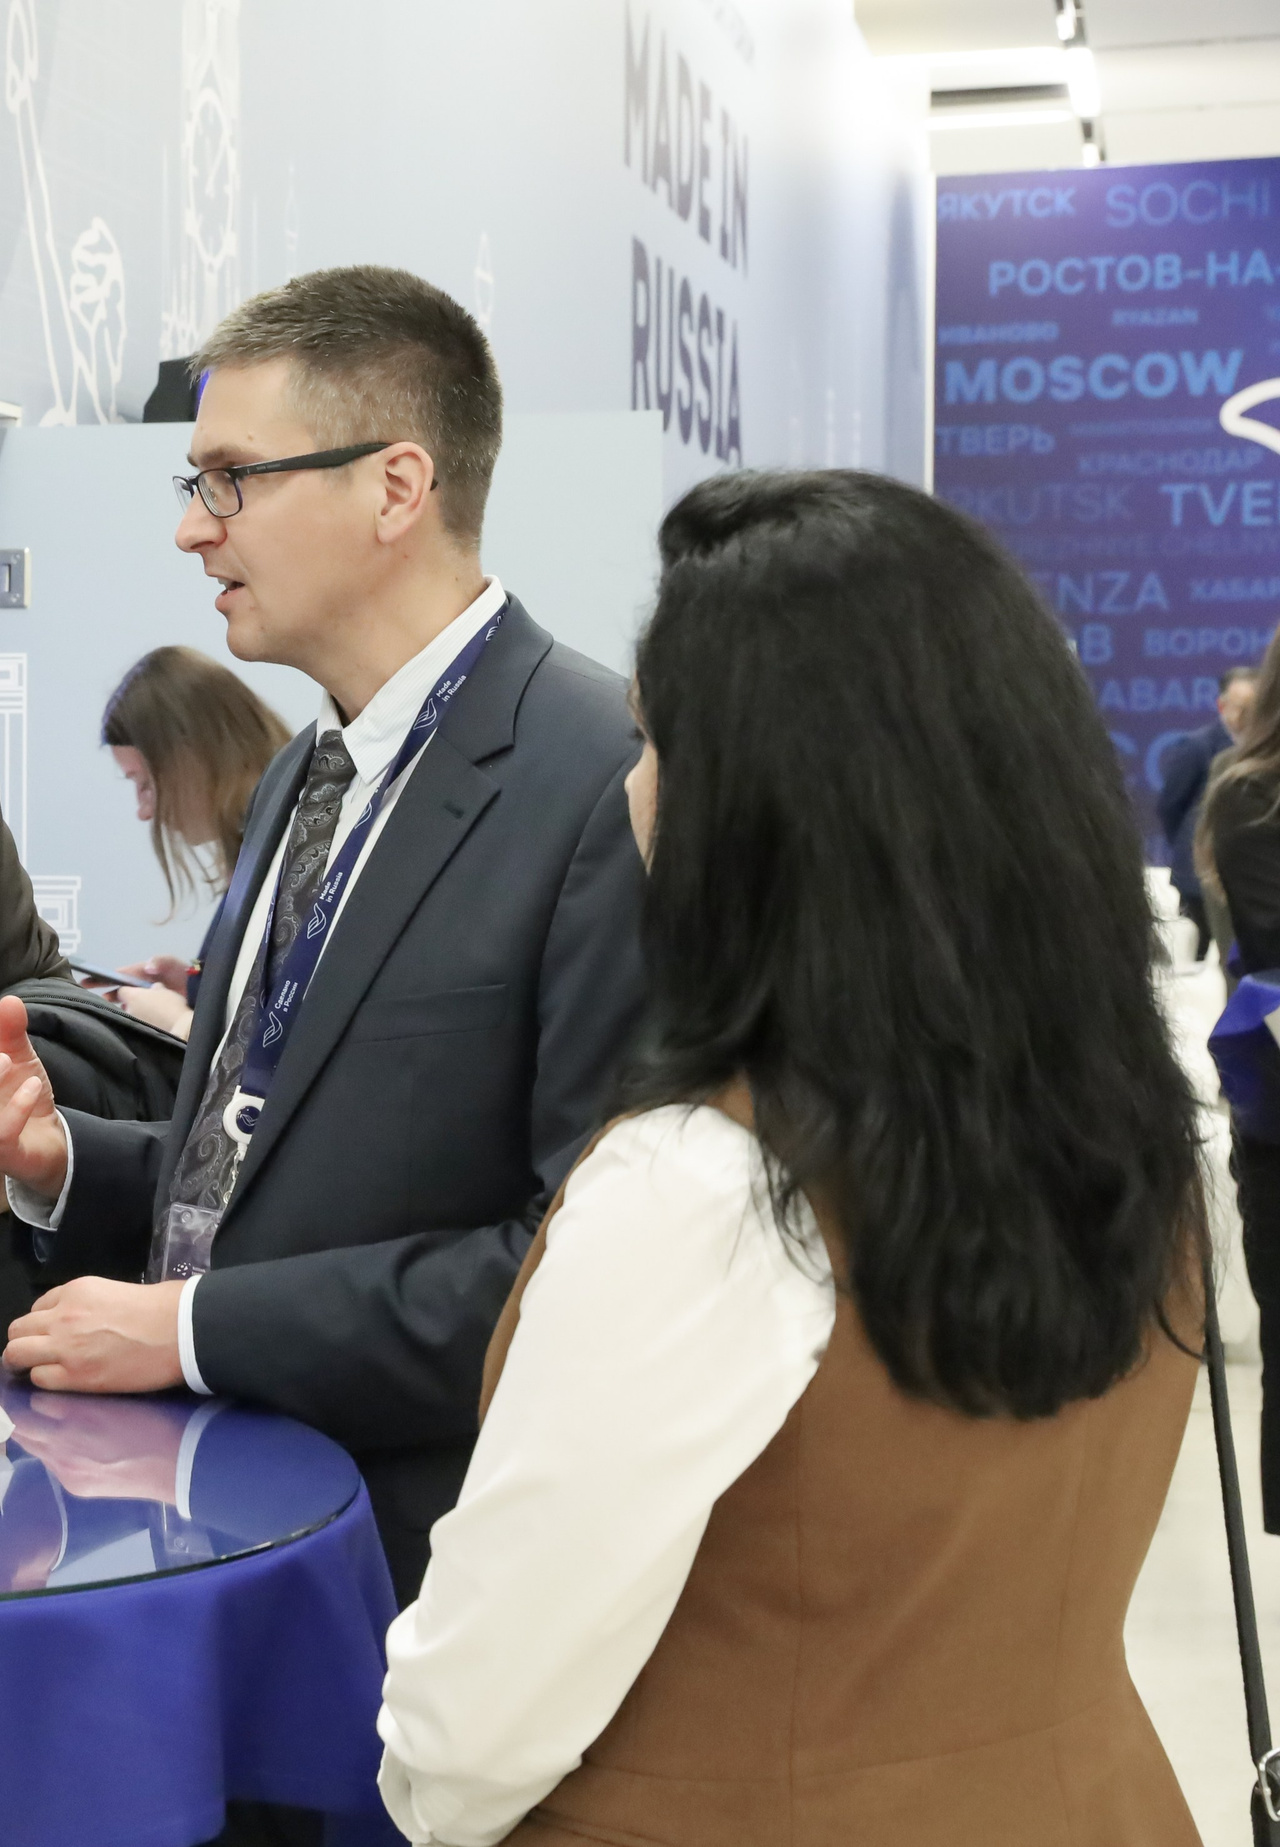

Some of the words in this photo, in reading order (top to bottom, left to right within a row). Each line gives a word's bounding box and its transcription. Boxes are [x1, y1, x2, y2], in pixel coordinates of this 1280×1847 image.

[624, 0, 712, 245] MADE
[719, 104, 750, 280] IN
[1105, 178, 1269, 229] SOCHI
[631, 232, 743, 470] RUSSIA
[943, 348, 1245, 405] MOSCOW
[935, 423, 1057, 456] ТВЕРЬ
[1159, 481, 1280, 527] TVE
[436, 680, 452, 698] Made
[447, 674, 467, 696] Russia
[319, 881, 331, 900] Made
[325, 894, 333, 903] in
[329, 871, 343, 895] Russia
[274, 980, 291, 1010] Сделано
[285, 982, 298, 1008] России
